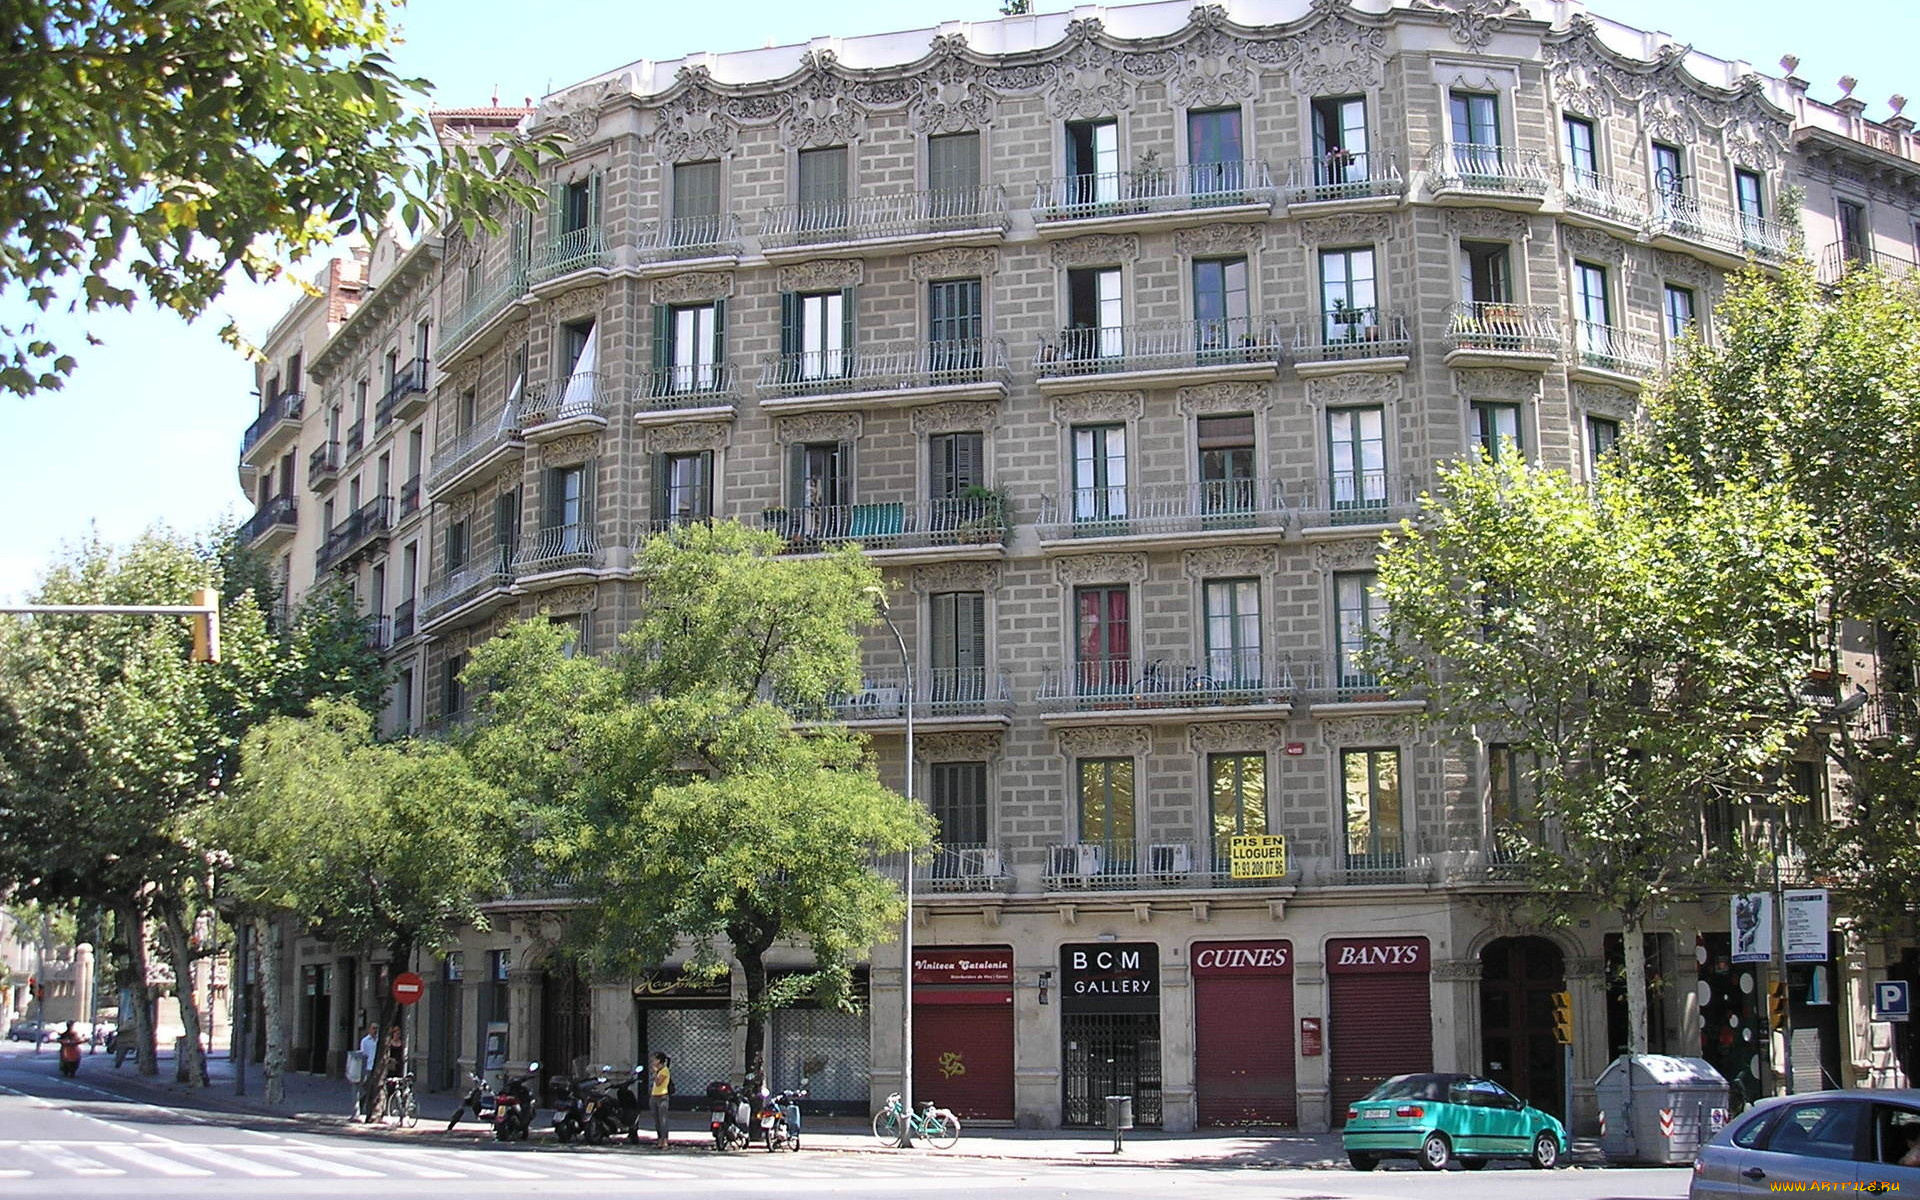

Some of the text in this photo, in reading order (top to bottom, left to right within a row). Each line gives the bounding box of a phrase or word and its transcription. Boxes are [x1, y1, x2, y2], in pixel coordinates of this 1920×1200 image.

[1233, 837, 1283, 847] PIS EN
[1233, 848, 1283, 859] LLOGUER
[1242, 861, 1250, 876] 93
[1265, 861, 1273, 875] 07
[1197, 948, 1288, 968] CUINES
[1337, 945, 1419, 965] BANYS
[914, 959, 1008, 971] Viniteca Catalonia
[1074, 980, 1151, 994] GALLERY
[1880, 985, 1901, 1010] P
